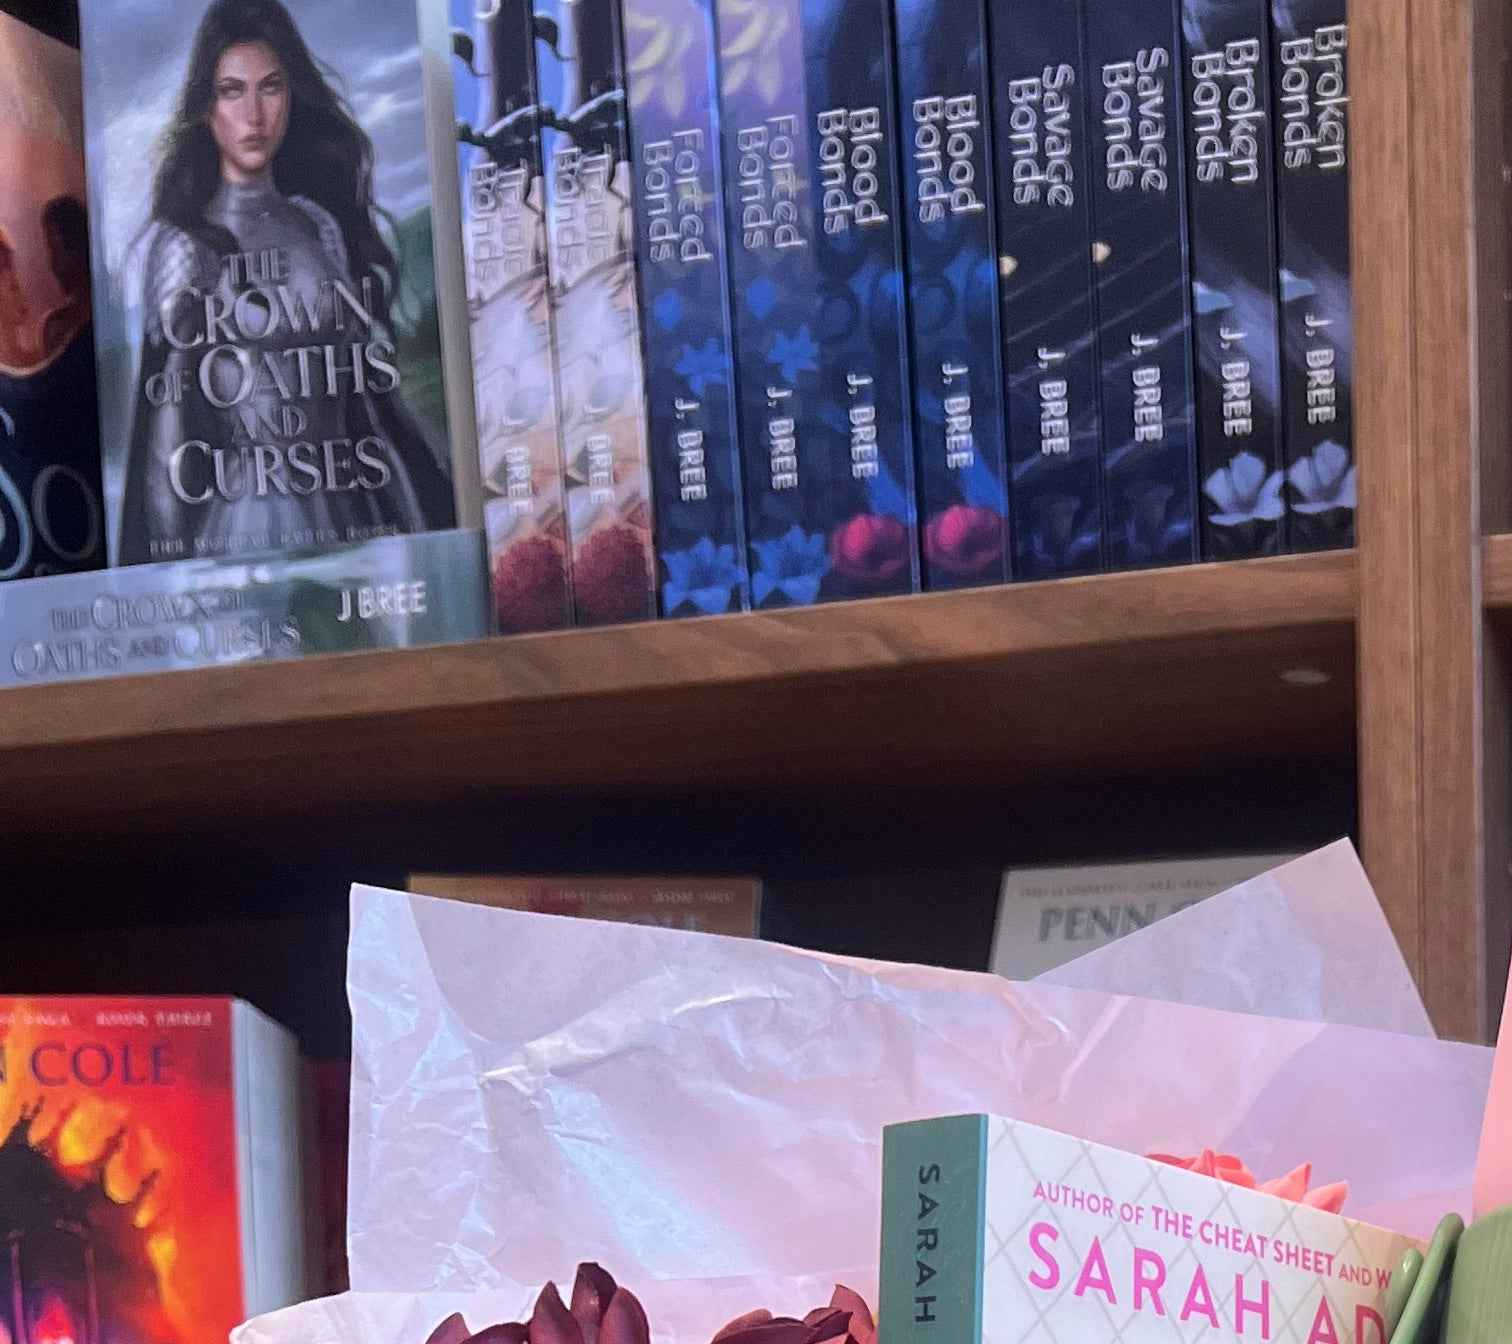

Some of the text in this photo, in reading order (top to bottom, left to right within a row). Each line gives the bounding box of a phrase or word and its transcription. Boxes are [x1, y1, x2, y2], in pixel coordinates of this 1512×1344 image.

[1007, 76, 1042, 205] Bonds
[1041, 62, 1075, 208] Savage
[1103, 62, 1136, 192] Bonds
[1135, 47, 1170, 194] Savage
[1191, 52, 1225, 183] Bonds
[1225, 39, 1261, 183] Broken
[1279, 39, 1314, 169] Bonds
[1314, 25, 1347, 169] Broken
[642, 140, 675, 263] Bonds
[674, 128, 714, 263] Forced
[736, 127, 768, 250] Bonds
[767, 114, 807, 249] Forced
[817, 108, 855, 235] Bonds
[849, 106, 889, 224] Blood
[912, 96, 947, 224] Bonds
[945, 94, 985, 214] Blood
[161, 278, 374, 350] CROWN
[226, 247, 288, 281] THE
[145, 342, 398, 409] OF OATHS
[236, 405, 307, 440] AND
[942, 362, 974, 470] J. BREE
[1037, 347, 1070, 455] J. BREE
[1130, 333, 1164, 443] J. BREE
[1219, 327, 1252, 436] J. BREE
[1304, 314, 1336, 425] J. BREE
[169, 436, 391, 504] CURSES
[674, 397, 708, 501] J. BREE
[767, 384, 798, 491] J. BREE
[847, 373, 879, 479] J. BREE
[90, 593, 210, 631] CROWN
[357, 580, 427, 620] BREE
[12, 638, 121, 678] OATHS
[1039, 903, 1157, 942] PENN
[30, 1040, 176, 1087] COLE
[913, 1163, 942, 1325] SARAH
[1028, 1221, 1270, 1341] SARAH
[1033, 1181, 1113, 1218] AUTHOR
[1119, 1203, 1144, 1225] OF
[1150, 1205, 1193, 1240] THE
[1199, 1221, 1269, 1259] CHEAT
[1273, 1240, 1334, 1277] SHEET
[1338, 1263, 1373, 1286] AND
